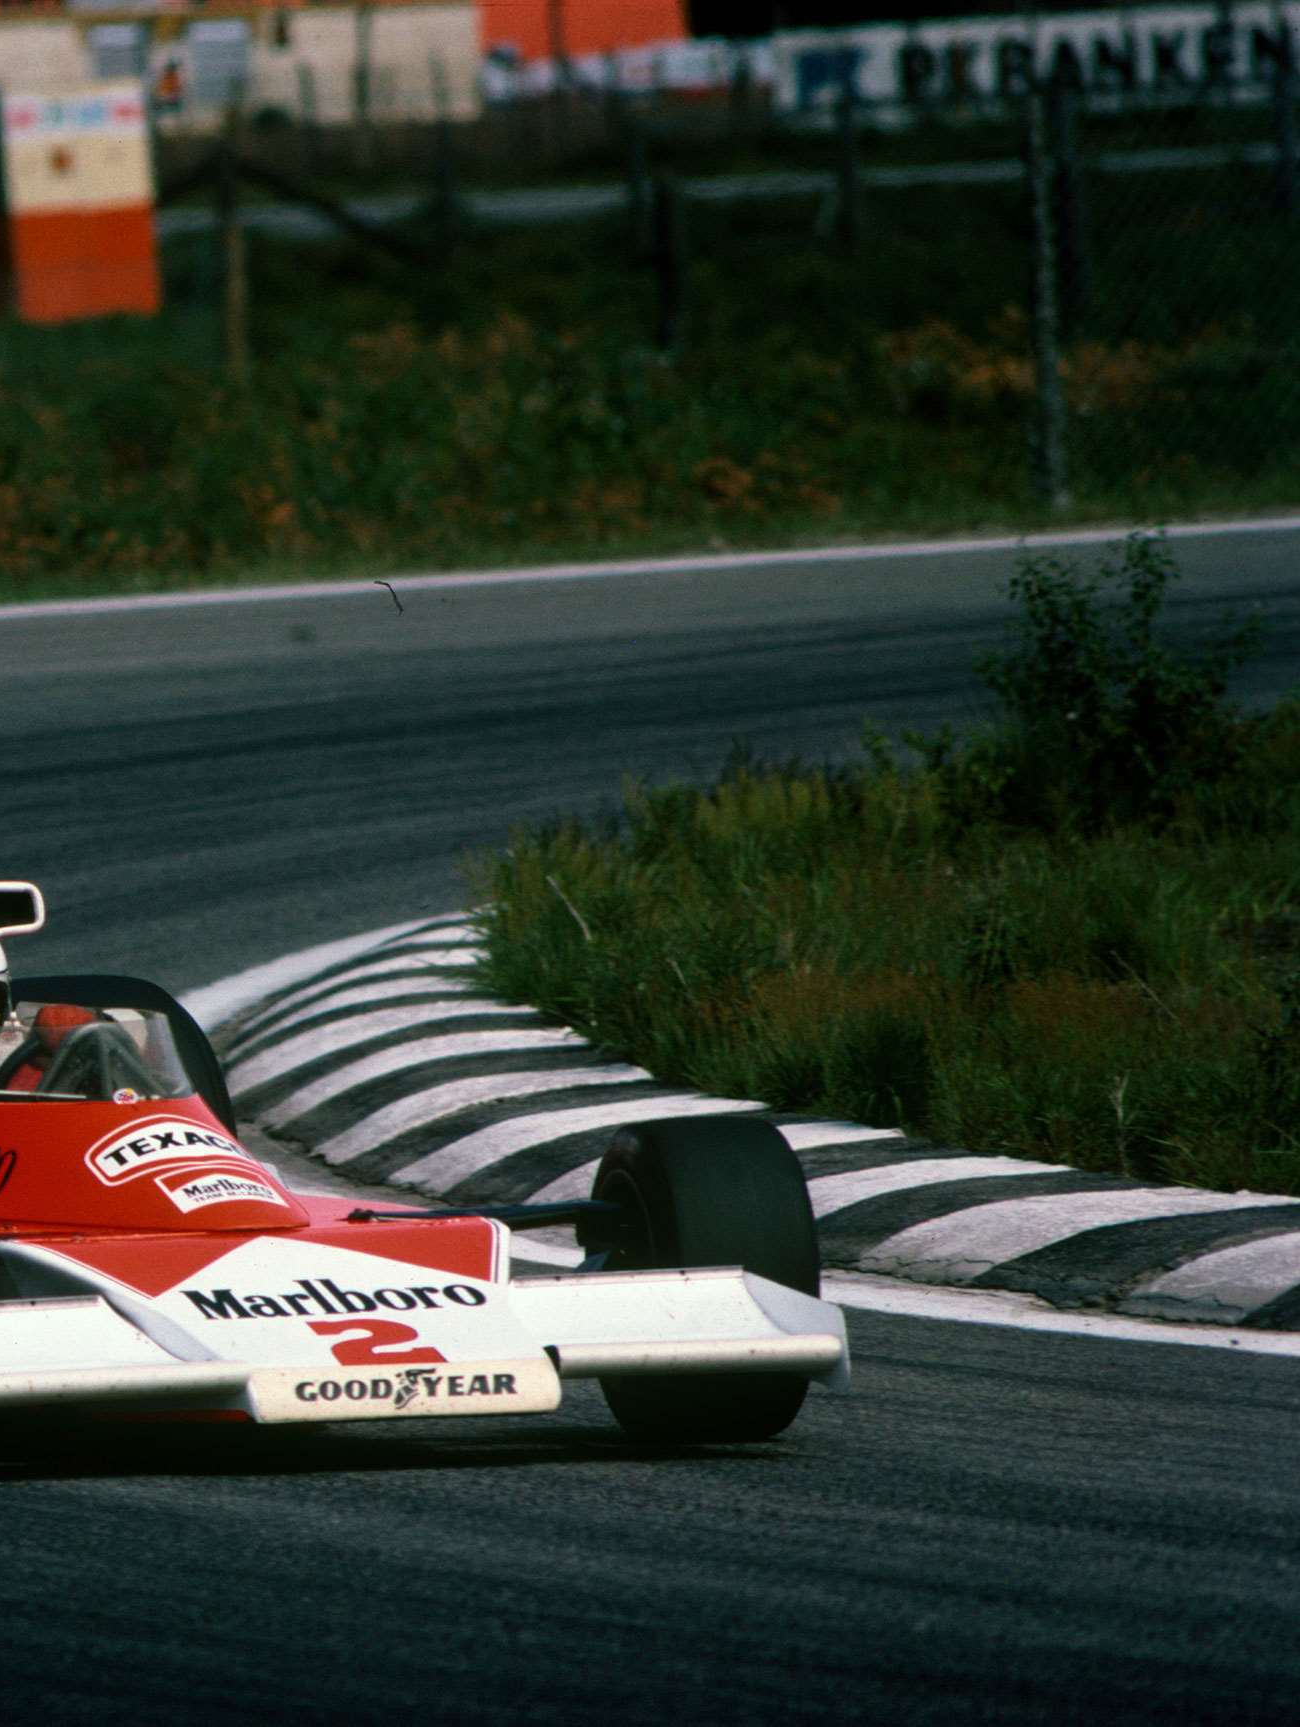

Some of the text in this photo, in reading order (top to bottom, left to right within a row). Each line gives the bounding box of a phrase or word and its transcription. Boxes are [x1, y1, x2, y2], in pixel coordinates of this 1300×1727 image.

[182, 1179, 274, 1197] Marlboro
[181, 1278, 487, 1320] Marlboro
[306, 1318, 449, 1366] 2
